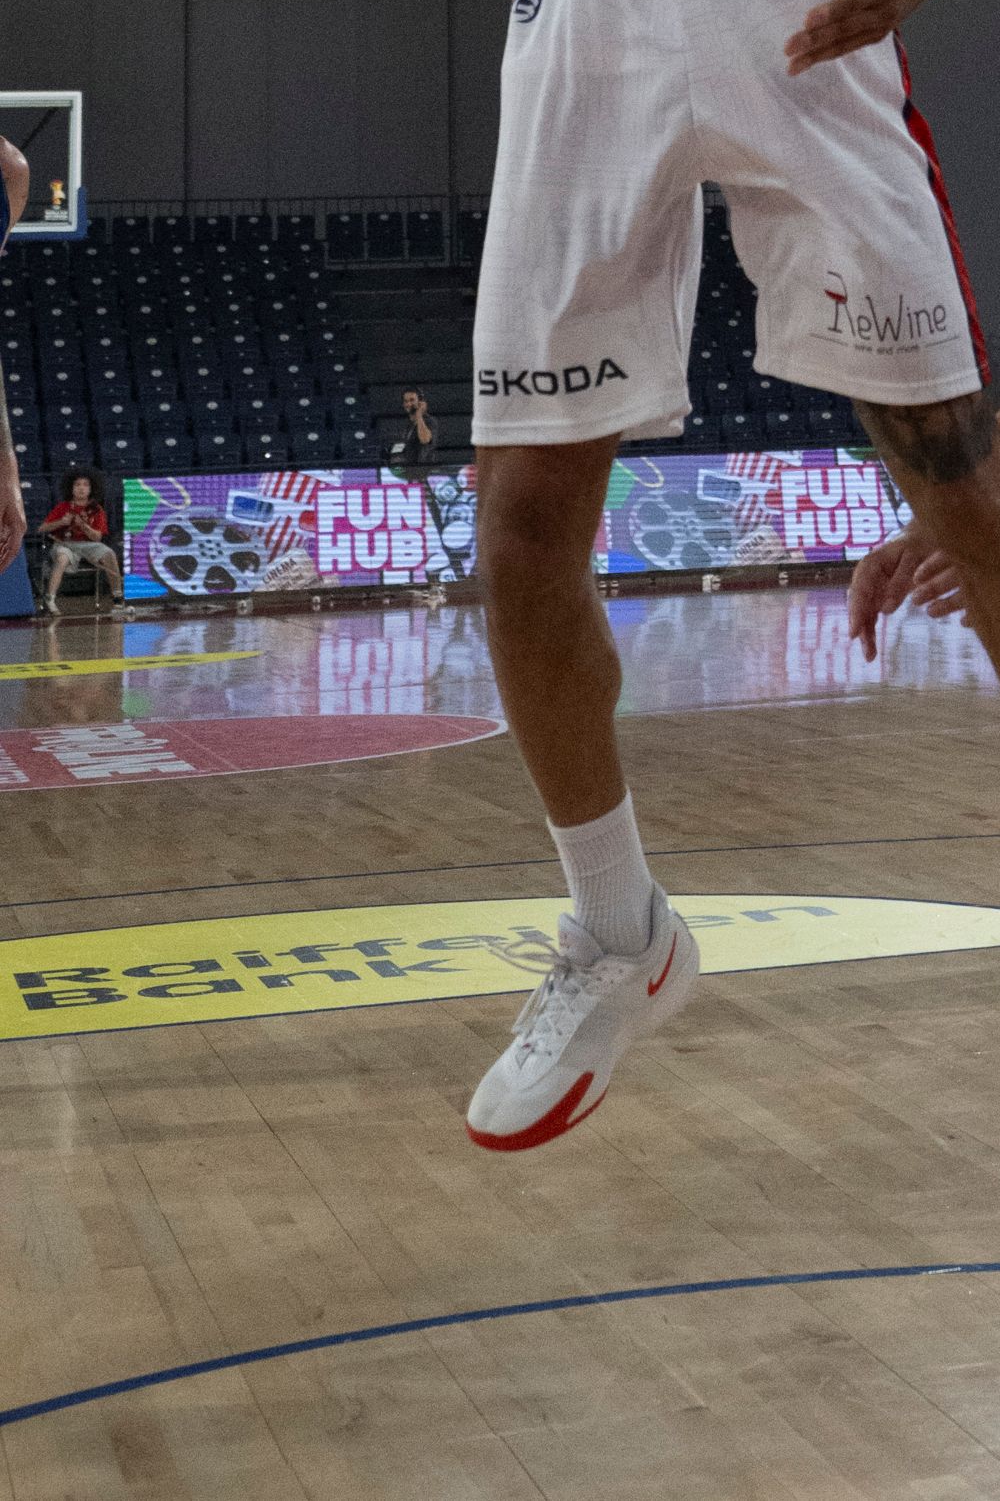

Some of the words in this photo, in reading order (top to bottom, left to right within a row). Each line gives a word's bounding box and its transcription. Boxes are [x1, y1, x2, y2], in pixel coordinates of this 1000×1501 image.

[317, 486, 423, 533] FUN
[780, 466, 879, 509] FUN
[783, 507, 884, 549] HUB
[318, 530, 425, 572] HUB
[13, 904, 839, 989] Raiffeien
[22, 958, 473, 1011] Bank
